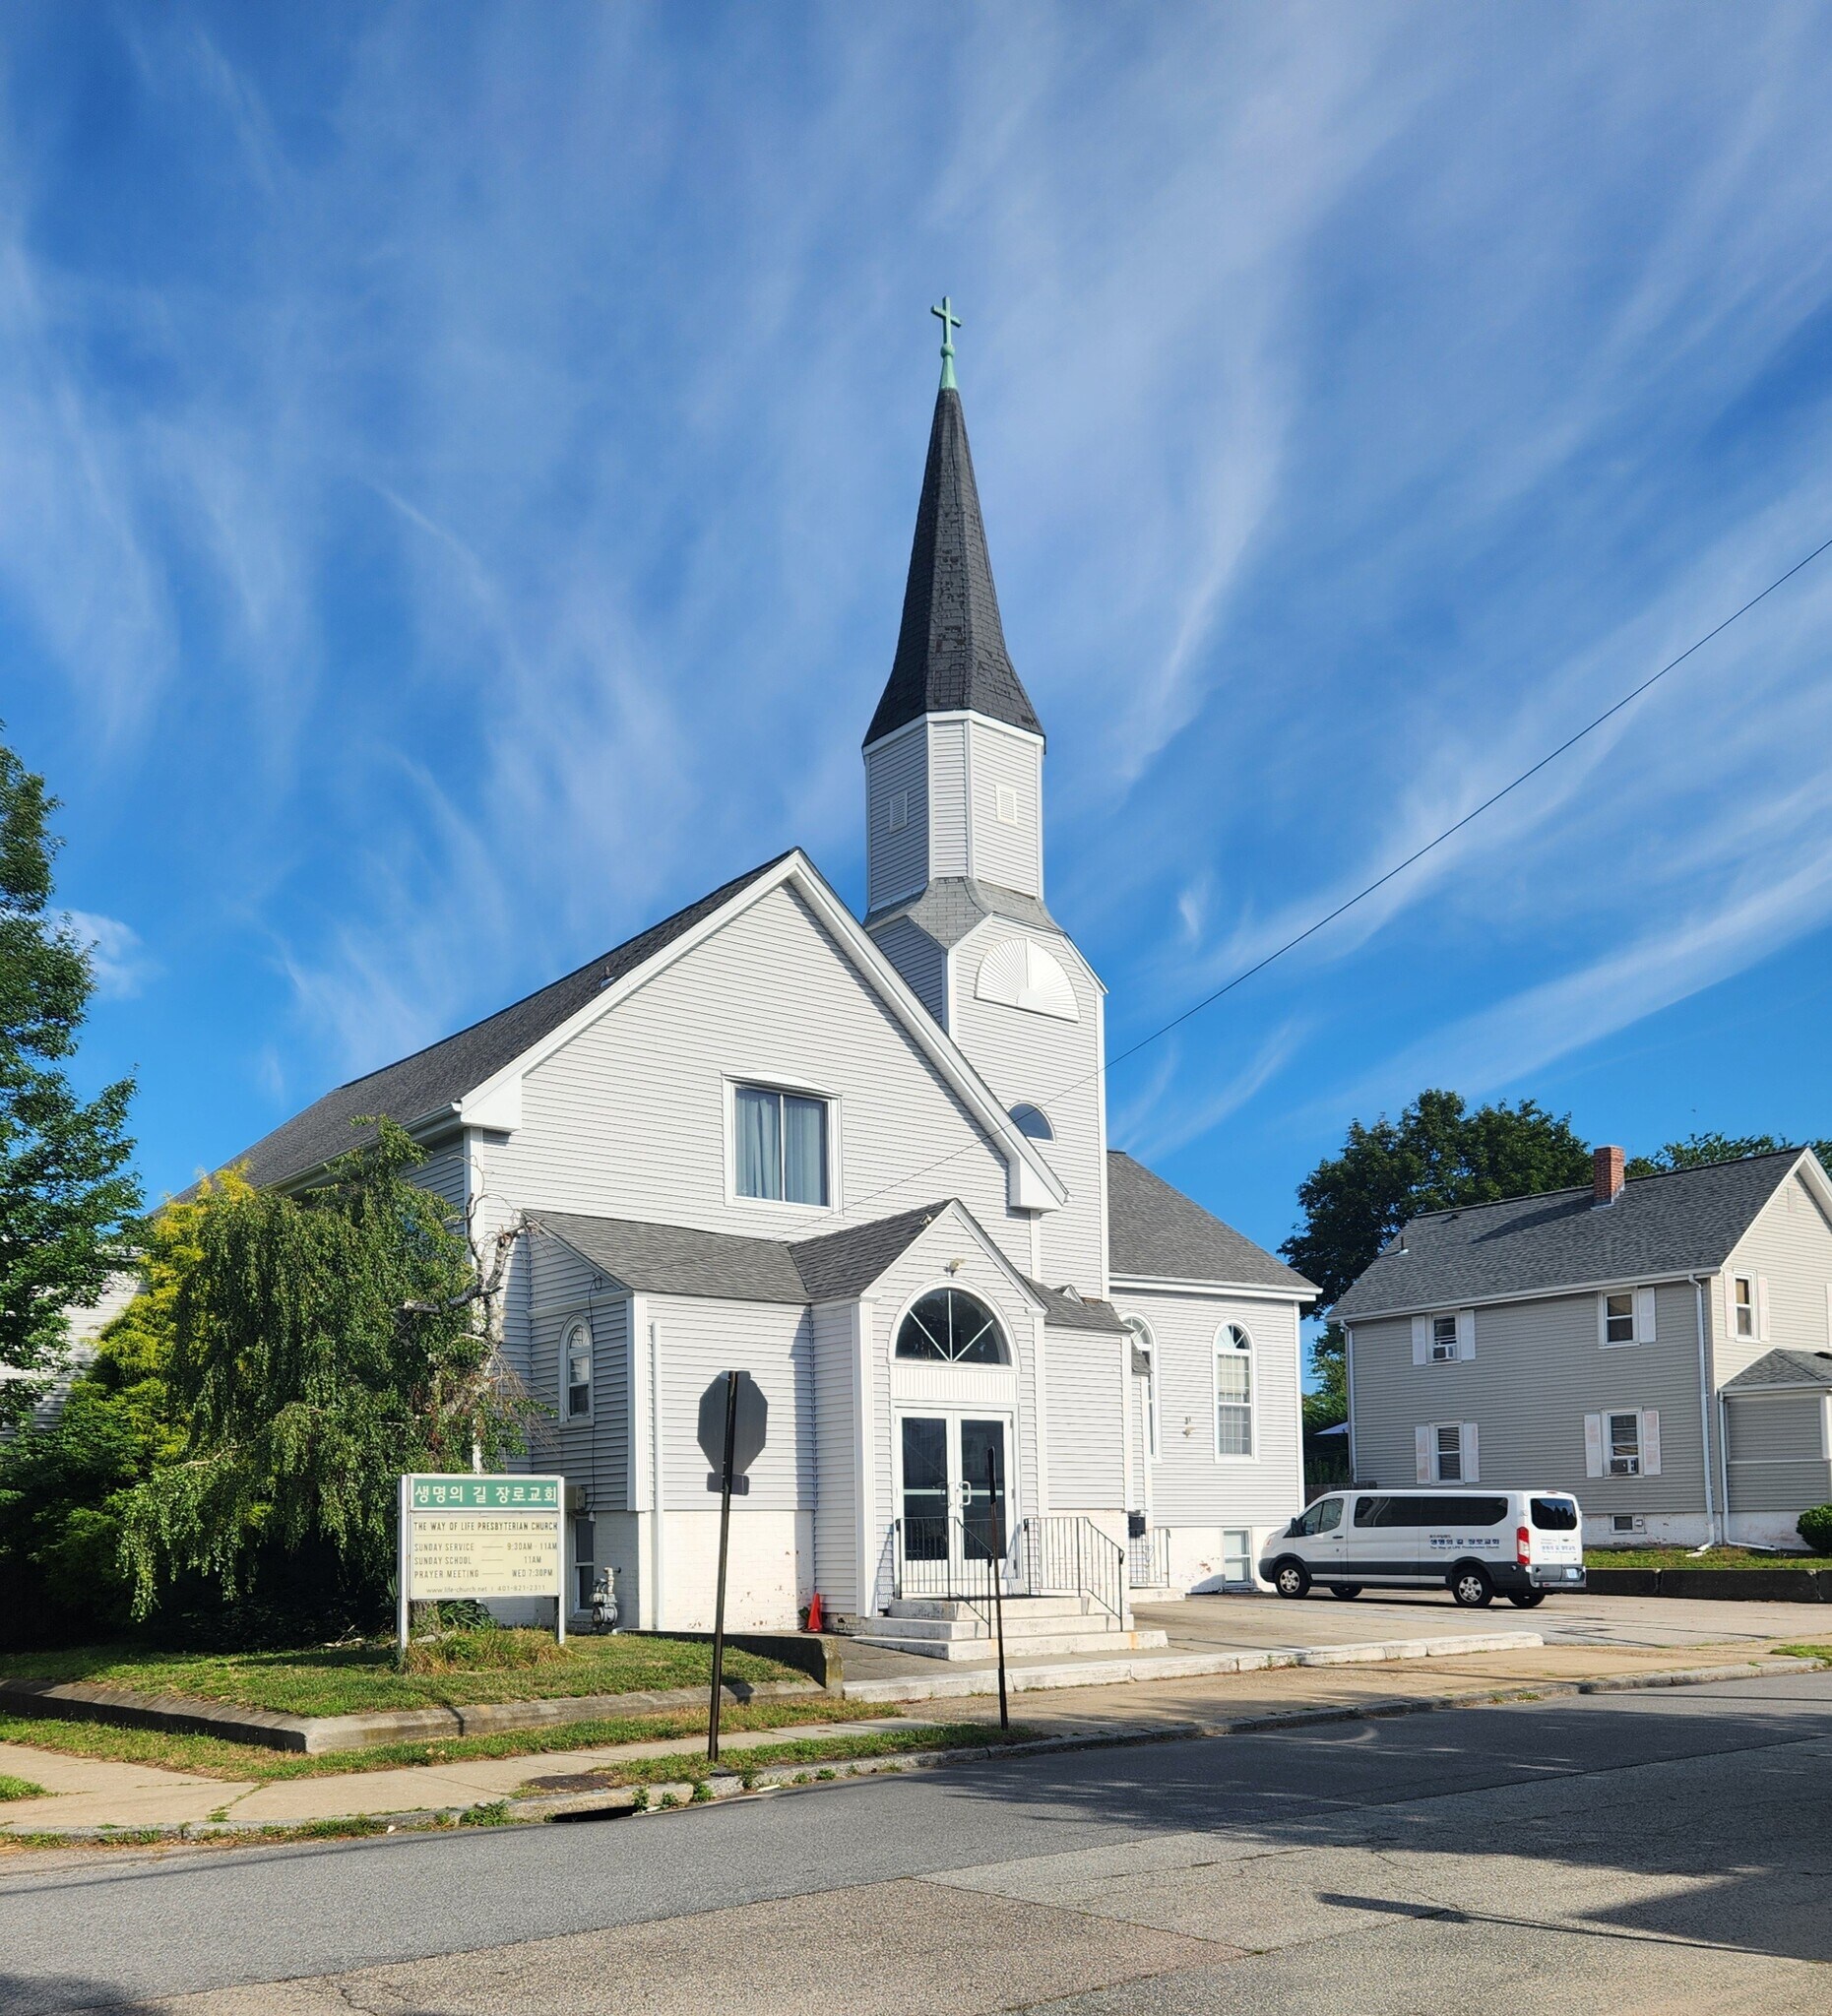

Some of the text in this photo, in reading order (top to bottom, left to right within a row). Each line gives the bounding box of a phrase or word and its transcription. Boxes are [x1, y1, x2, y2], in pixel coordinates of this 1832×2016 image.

[414, 1484, 557, 1503] 생명의 길 장로교회
[413, 1521, 558, 1531] THE WAY OF LIFE PRESBYTERIAN CHURCH
[413, 1543, 443, 1551] SUNDAY
[445, 1543, 474, 1551] SERVICE
[506, 1542, 533, 1550] 9:30AM
[539, 1542, 558, 1550] 11AM
[413, 1556, 443, 1565] SUNDAY
[524, 1555, 542, 1564] 11AM
[413, 1570, 444, 1579] PRAYER
[446, 1569, 479, 1578] MEETING
[528, 1568, 553, 1577] 7:30PM
